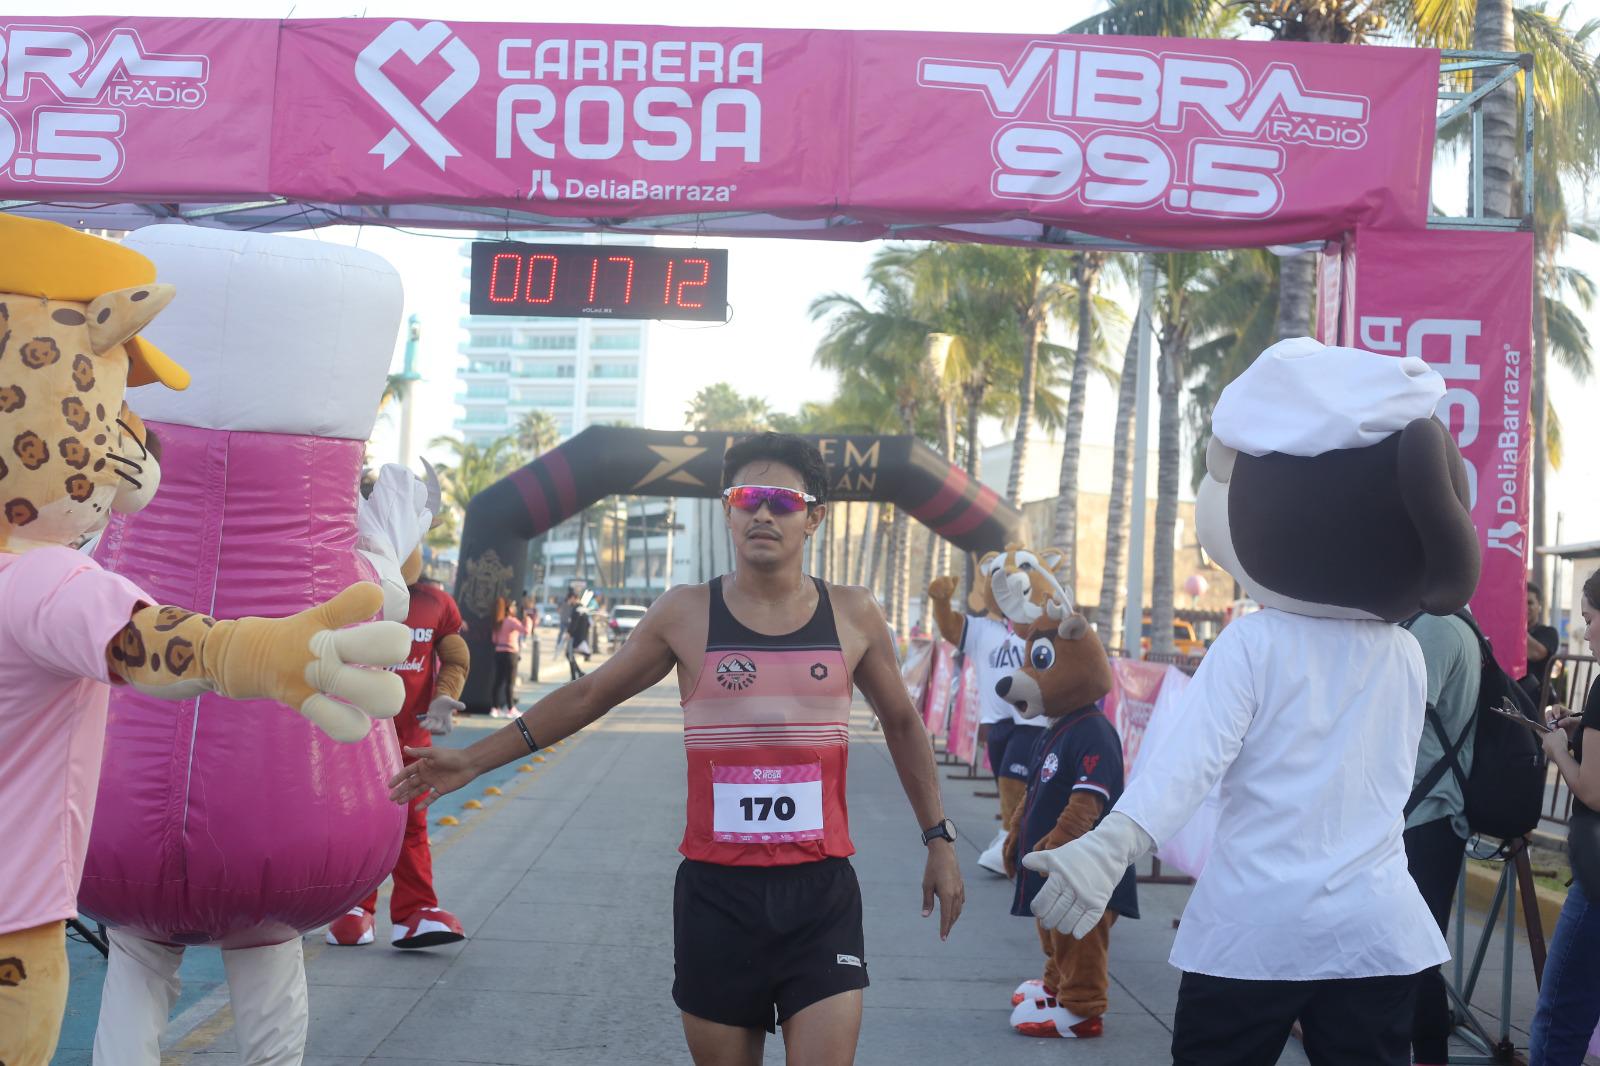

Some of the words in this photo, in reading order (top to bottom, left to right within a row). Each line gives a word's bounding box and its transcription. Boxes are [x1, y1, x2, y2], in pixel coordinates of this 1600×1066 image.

[497, 38, 763, 84] CARRERA
[114, 85, 200, 103] RADIO
[922, 46, 1364, 133] VIBRA
[496, 84, 761, 162] ROSA
[1273, 121, 1361, 144] RADIO
[998, 127, 1281, 214] 99.5
[489, 253, 558, 303] 00
[588, 256, 634, 304] 17
[663, 258, 710, 308] 12
[739, 796, 796, 821] 170
